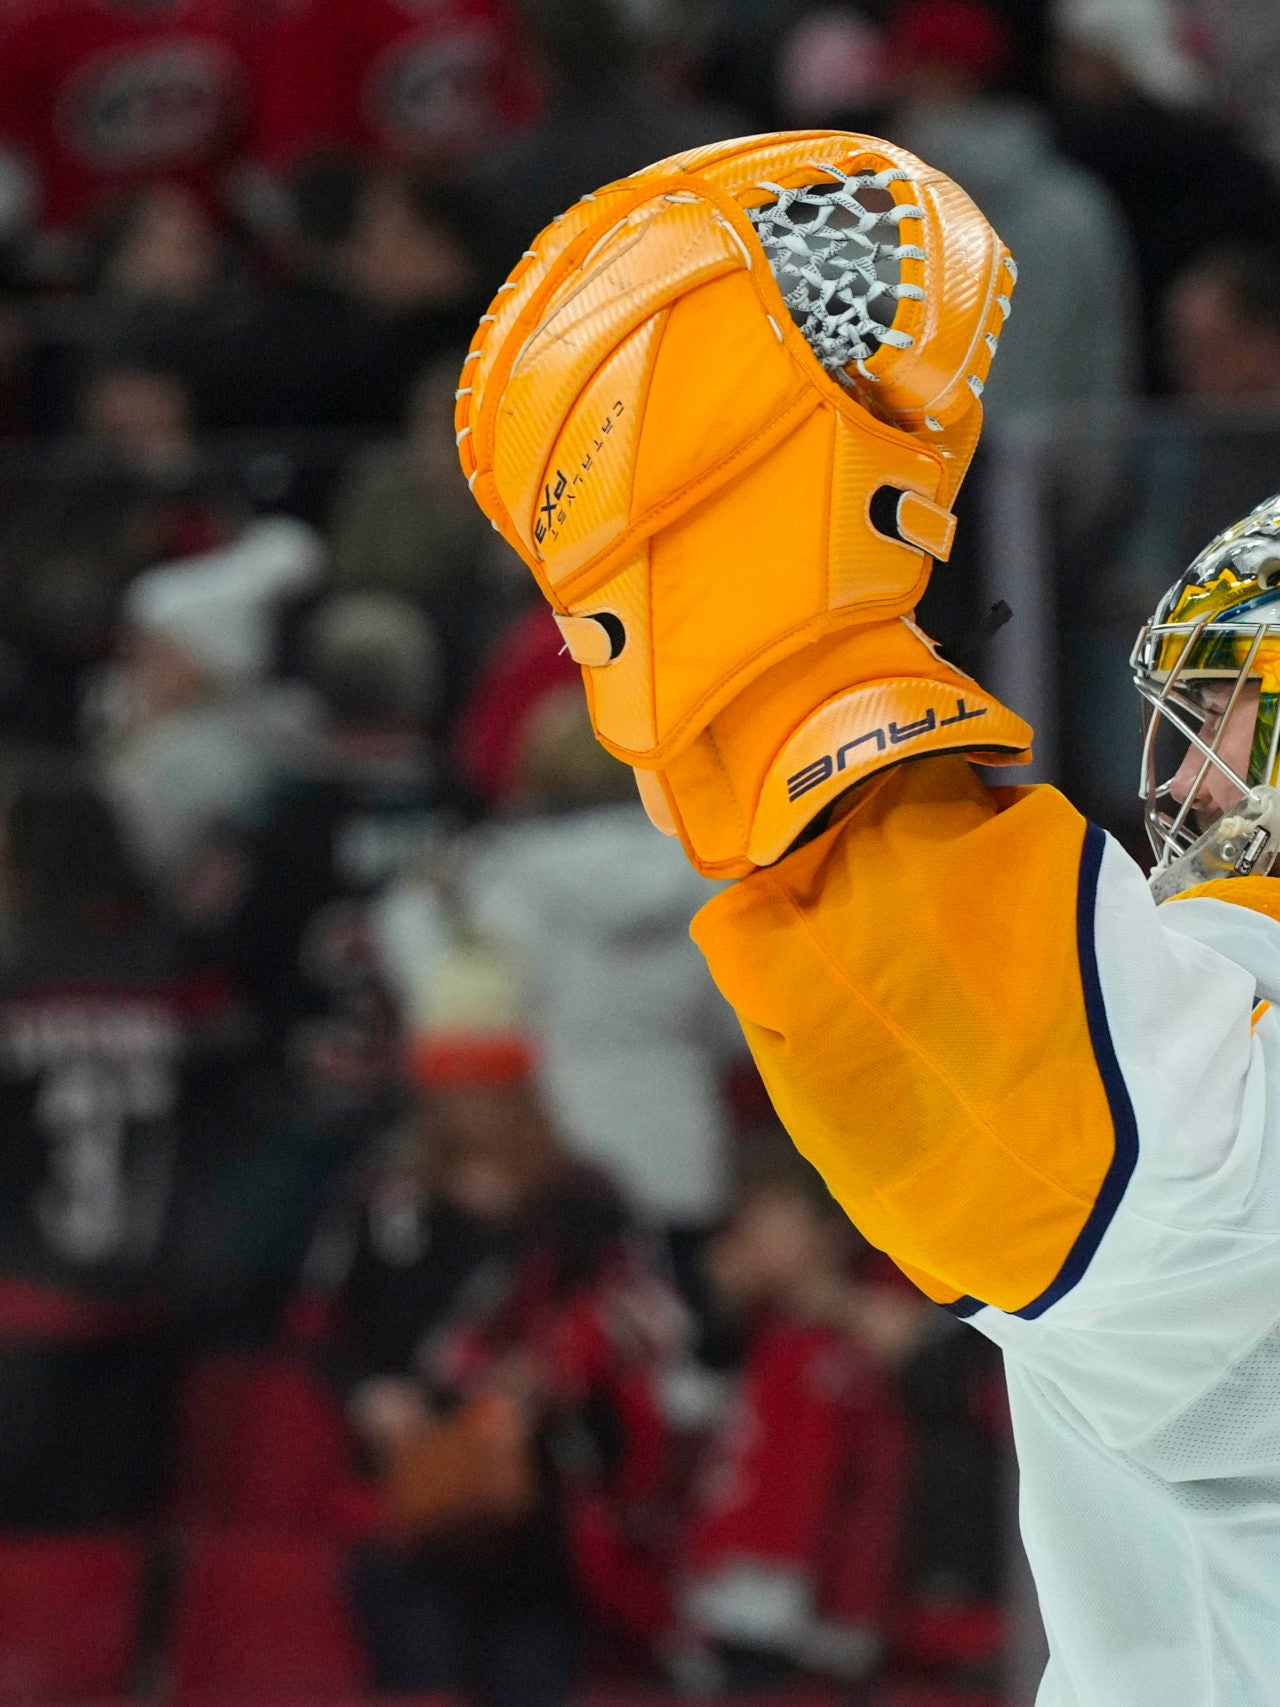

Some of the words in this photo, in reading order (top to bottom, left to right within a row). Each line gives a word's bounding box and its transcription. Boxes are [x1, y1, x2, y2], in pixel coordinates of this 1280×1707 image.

[534, 470, 568, 544] PX3
[552, 400, 625, 542] CATALYST
[787, 698, 988, 803] TRUE
